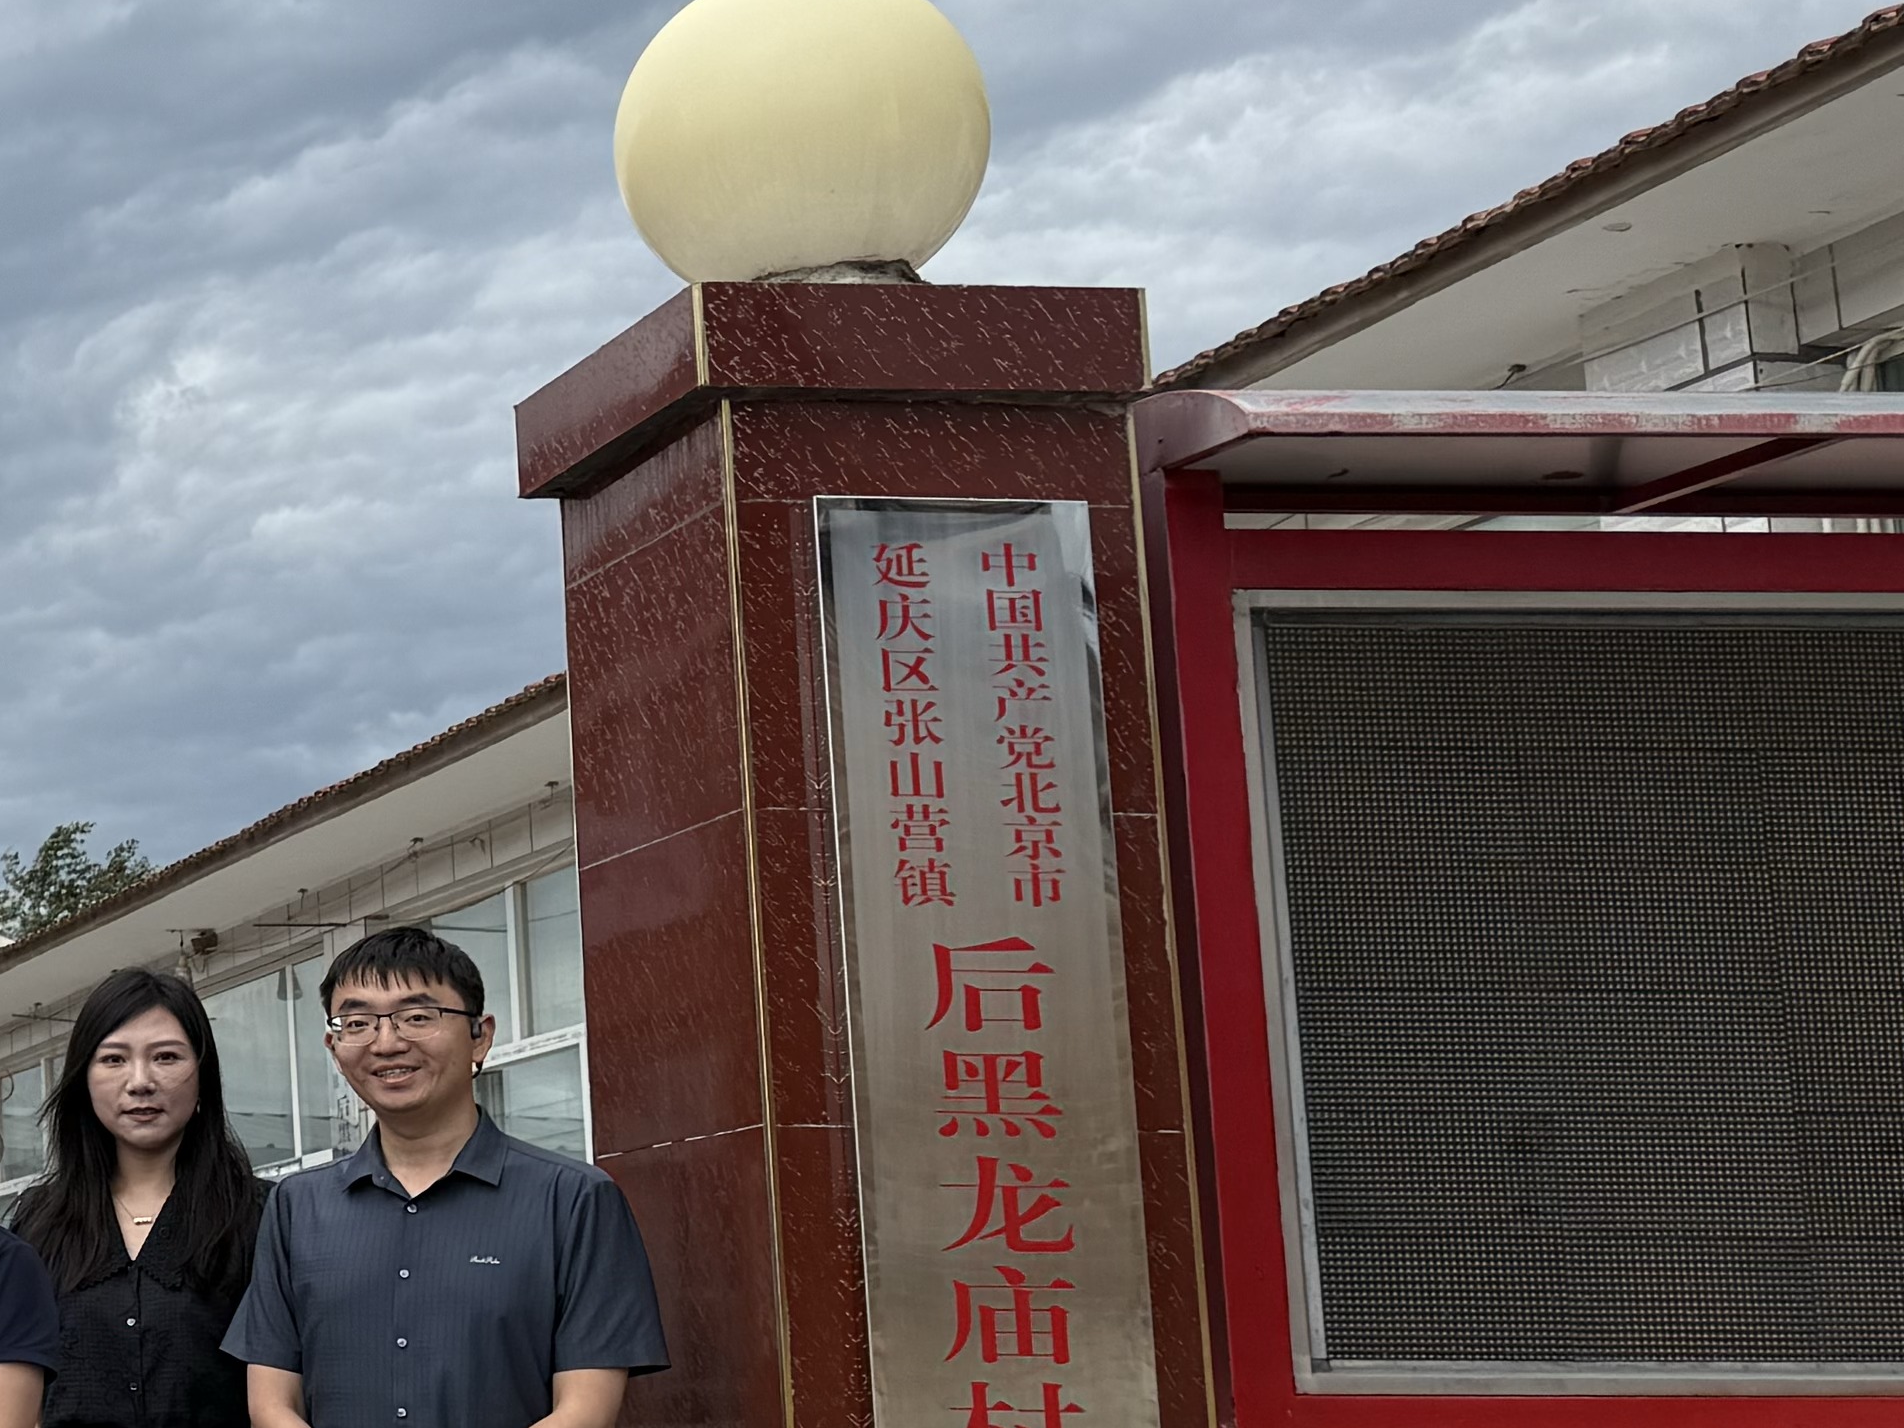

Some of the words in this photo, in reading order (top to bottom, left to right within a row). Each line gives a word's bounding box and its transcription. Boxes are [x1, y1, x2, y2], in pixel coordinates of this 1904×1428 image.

[871, 543, 957, 907] 延庆区张山营镇
[981, 543, 1066, 908] 中国共产党北京市
